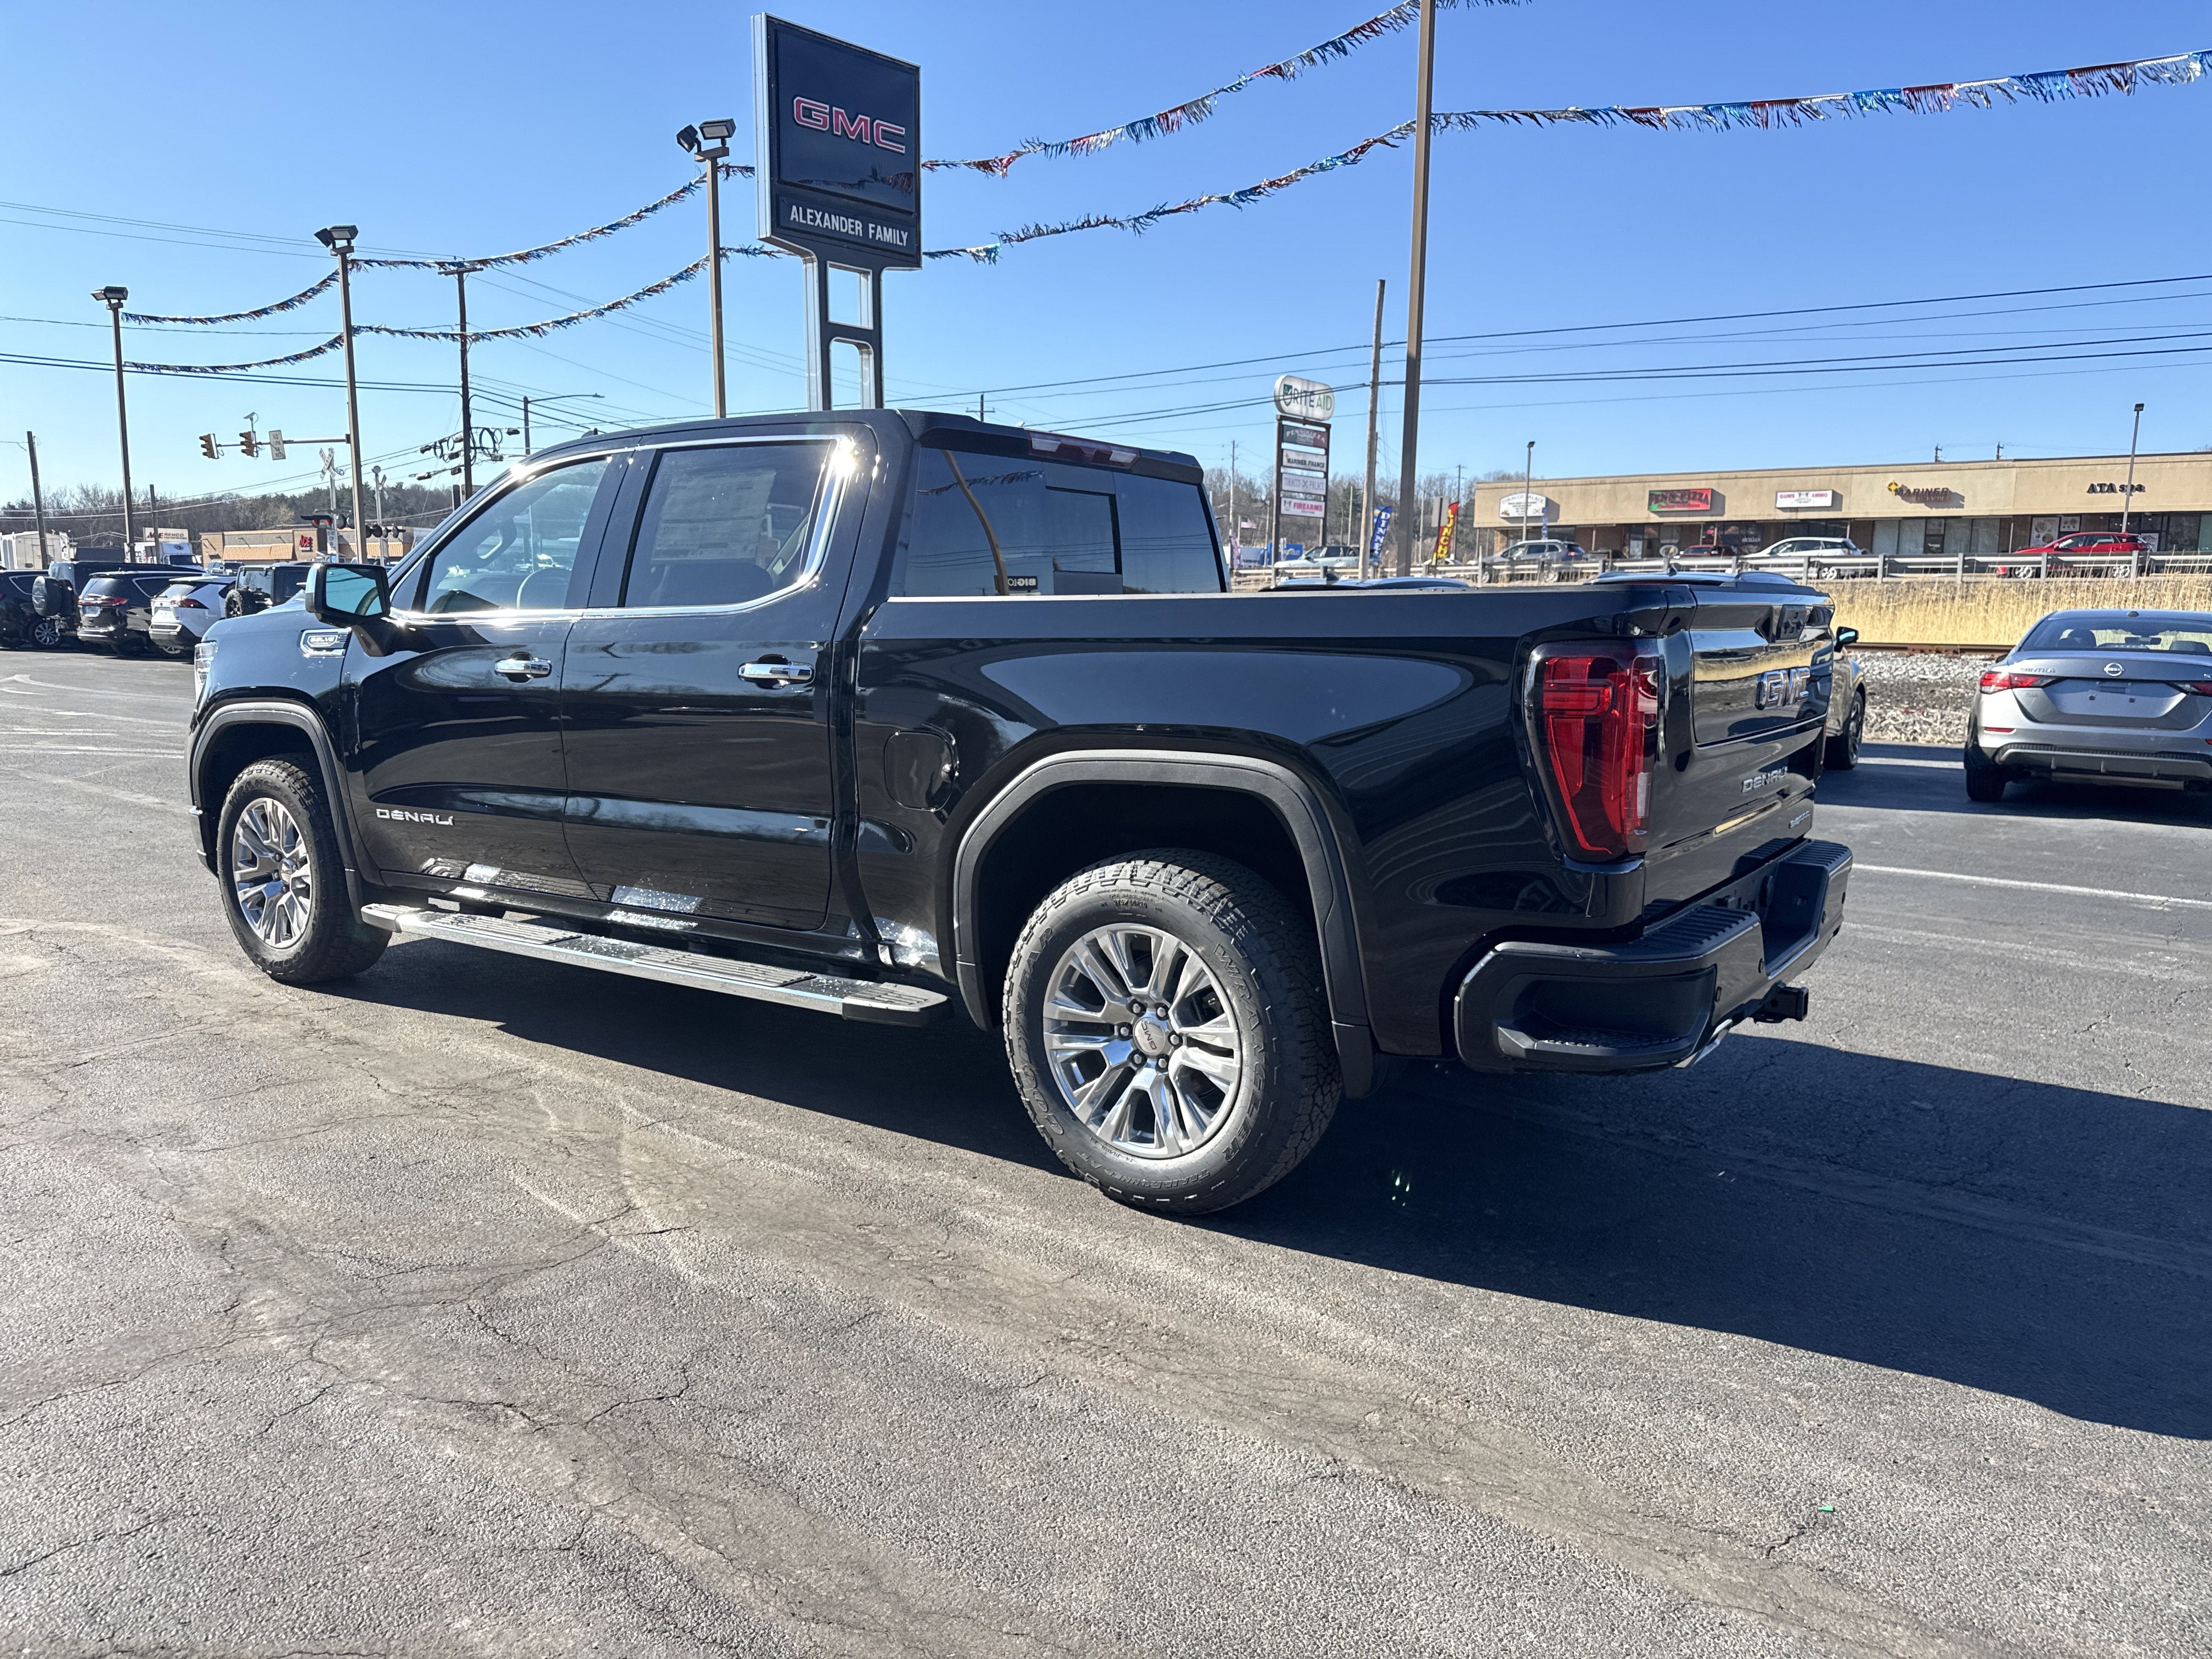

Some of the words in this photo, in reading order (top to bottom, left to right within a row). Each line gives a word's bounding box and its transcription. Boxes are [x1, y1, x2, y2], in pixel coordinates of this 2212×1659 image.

[793, 96, 906, 154] GMC
[789, 205, 863, 237] ALEXANDER
[868, 223, 908, 246] FAMILY
[1293, 388, 1314, 408] RITE
[1316, 394, 1333, 410] AID
[2086, 483, 2117, 493] ATA
[1293, 501, 1323, 512] FIREARMS
[298, 535, 312, 548] ACE
[1762, 667, 1810, 708] GMC
[1741, 766, 1788, 793] DENALI
[376, 809, 454, 826] DENALI
[1015, 927, 1063, 1135] GOODYEAR
[1141, 1020, 1157, 1050] GMC
[1213, 944, 1266, 1162] WRANGLER
